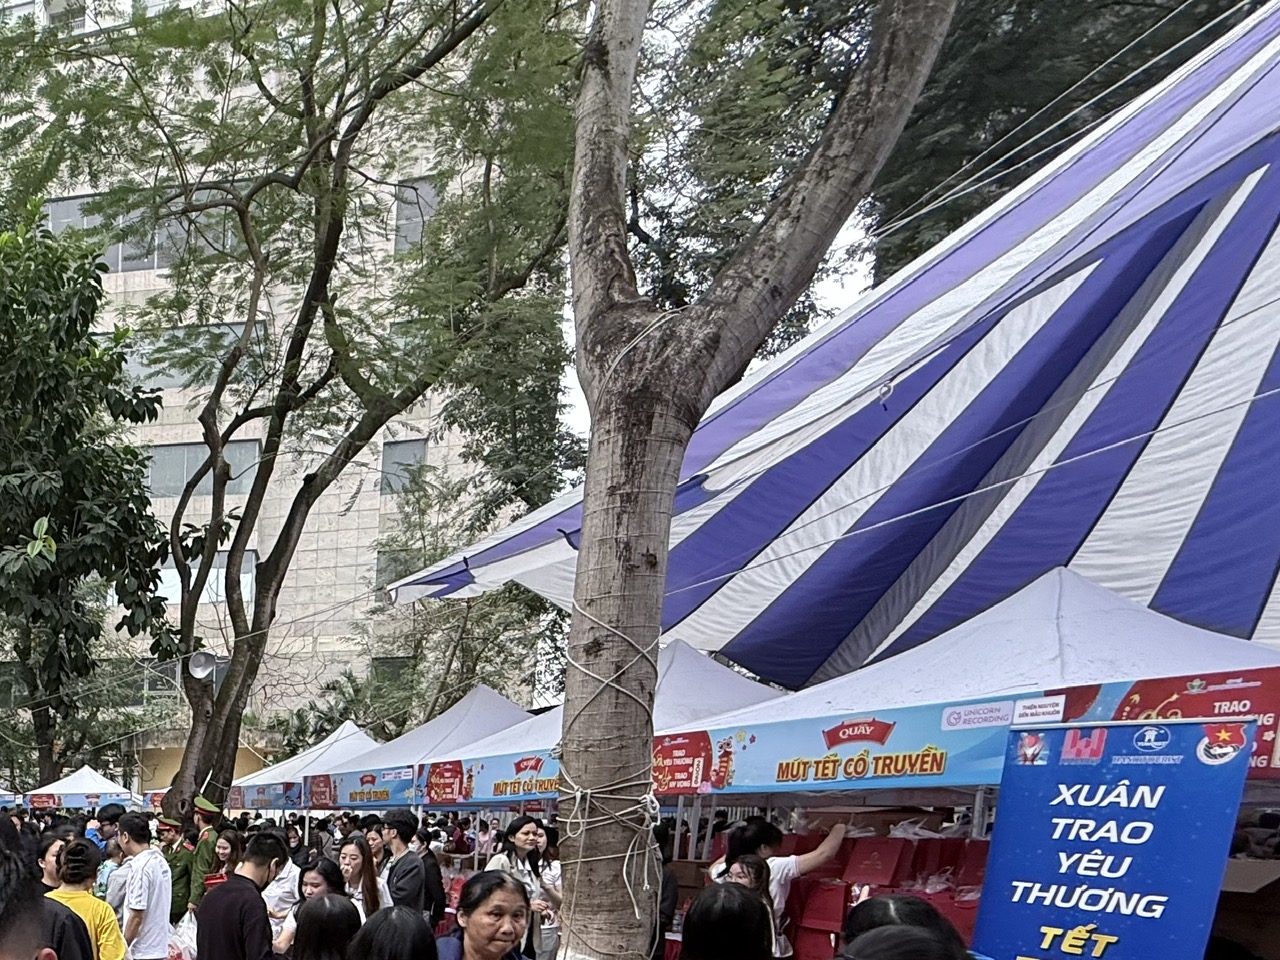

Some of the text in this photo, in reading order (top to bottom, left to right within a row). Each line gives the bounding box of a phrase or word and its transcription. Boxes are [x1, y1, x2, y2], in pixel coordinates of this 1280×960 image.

[962, 714, 1009, 725] RECORDING
[963, 706, 1001, 717] UNICORN
[1213, 700, 1251, 714] TRAO
[838, 724, 875, 739] QUẦY
[776, 744, 947, 782] MÚT TẾT CỔ TRUYỀN
[1049, 780, 1166, 808] XUÂN
[1050, 817, 1154, 845] TRAO
[1056, 849, 1133, 878] YÊU
[1010, 881, 1169, 919] THƯƠNG
[1039, 924, 1119, 958] TẾT
